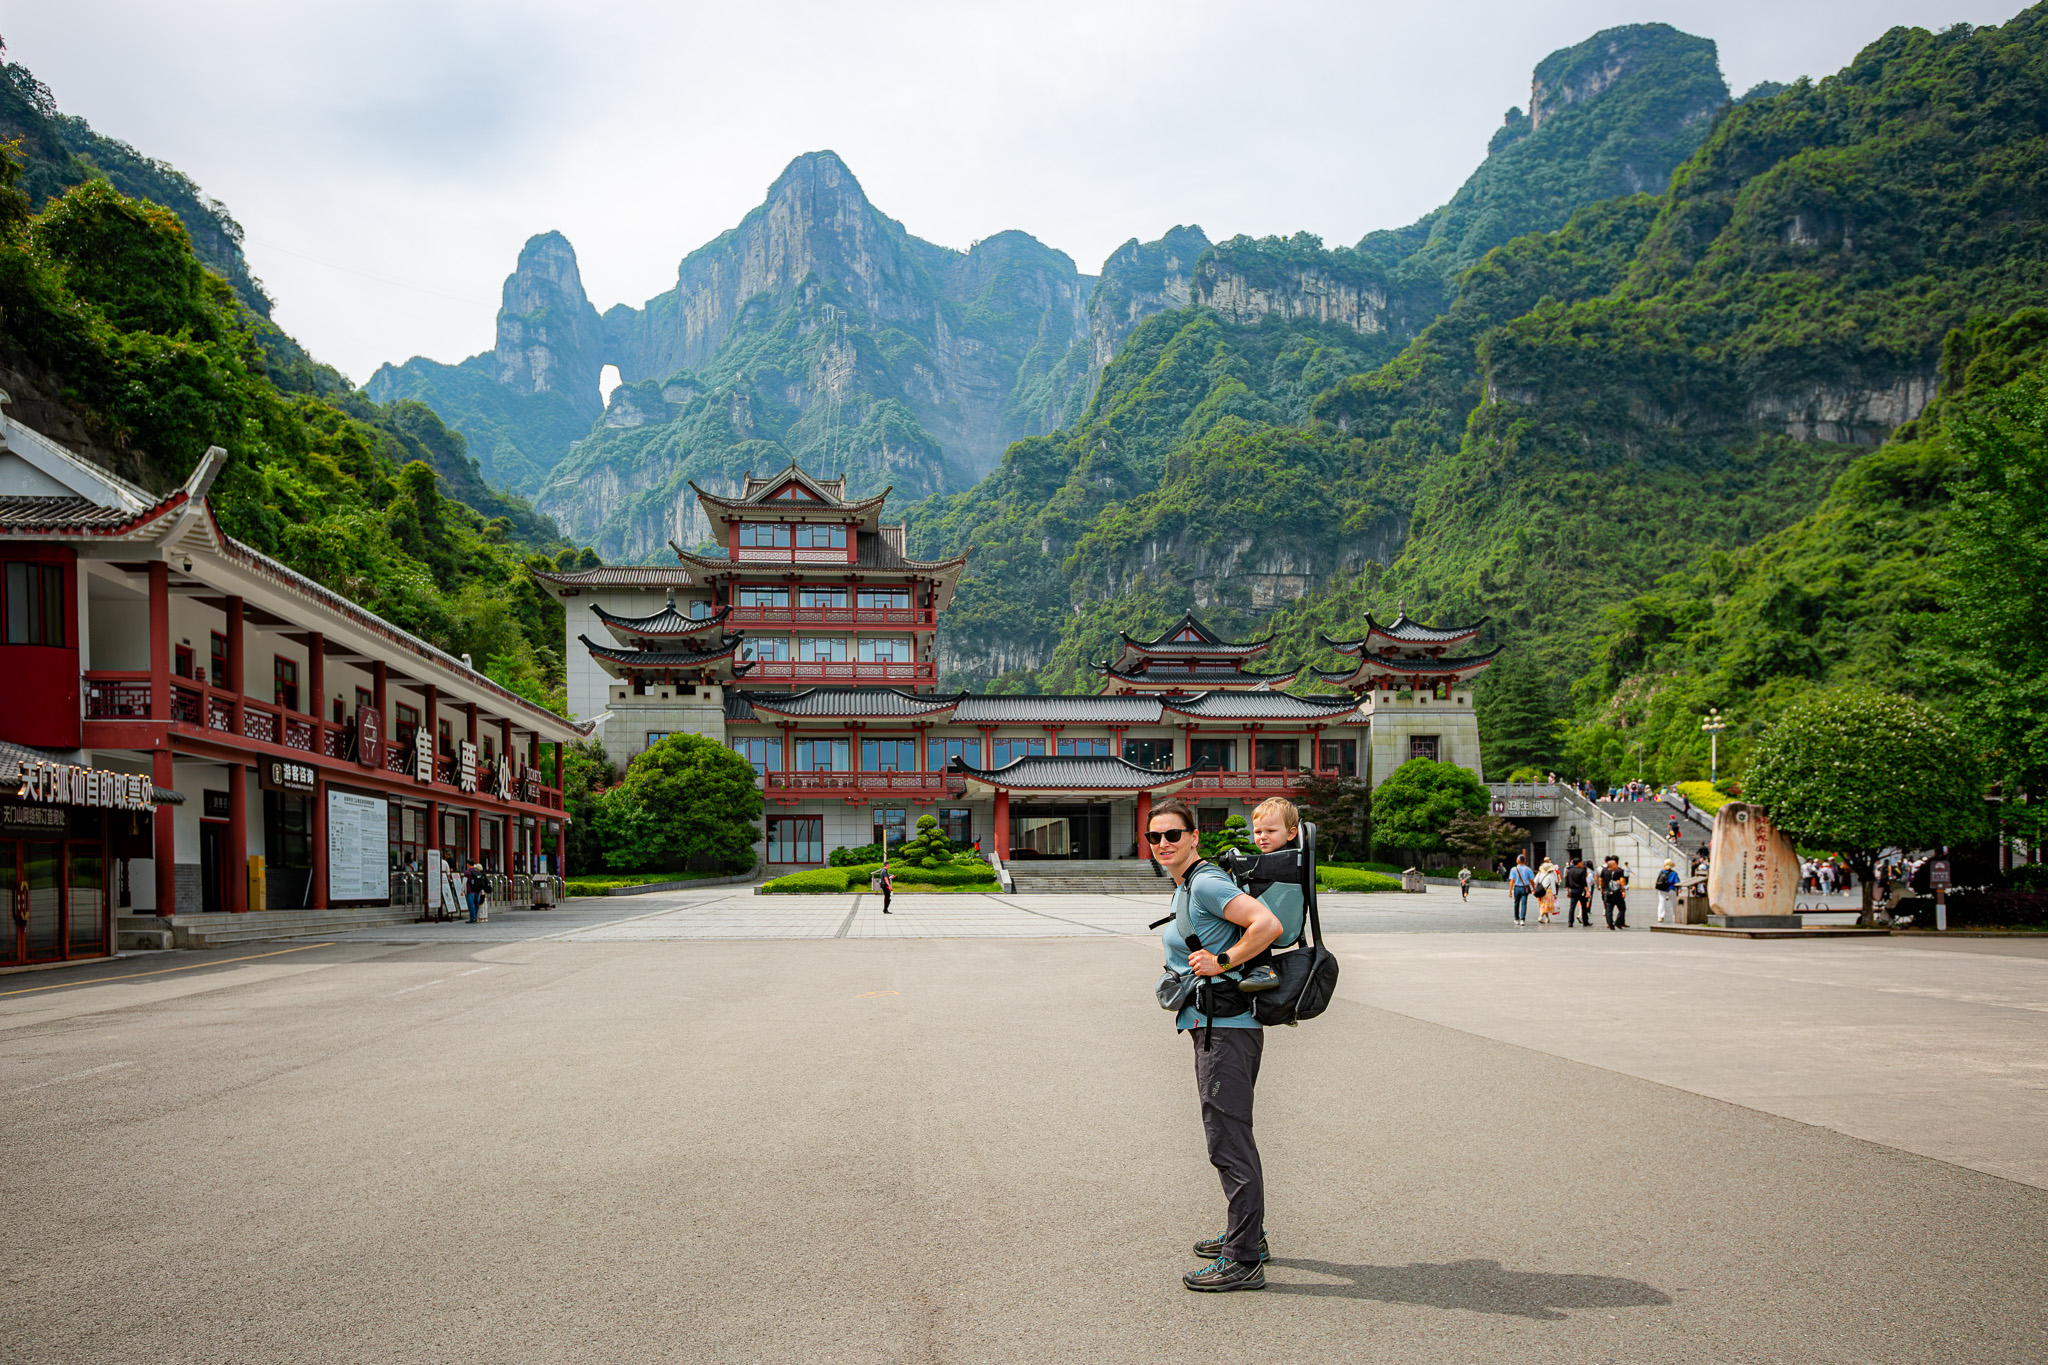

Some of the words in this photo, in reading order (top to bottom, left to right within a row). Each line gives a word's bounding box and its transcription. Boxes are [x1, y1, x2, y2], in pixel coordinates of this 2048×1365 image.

[283, 763, 314, 785] 游客咨询
[416, 726, 511, 800] 售票处
[527, 767, 542, 783] TICKETS
[22, 763, 155, 811] 天门狐仙自助取票处
[1508, 801, 1543, 811] 卫生间
